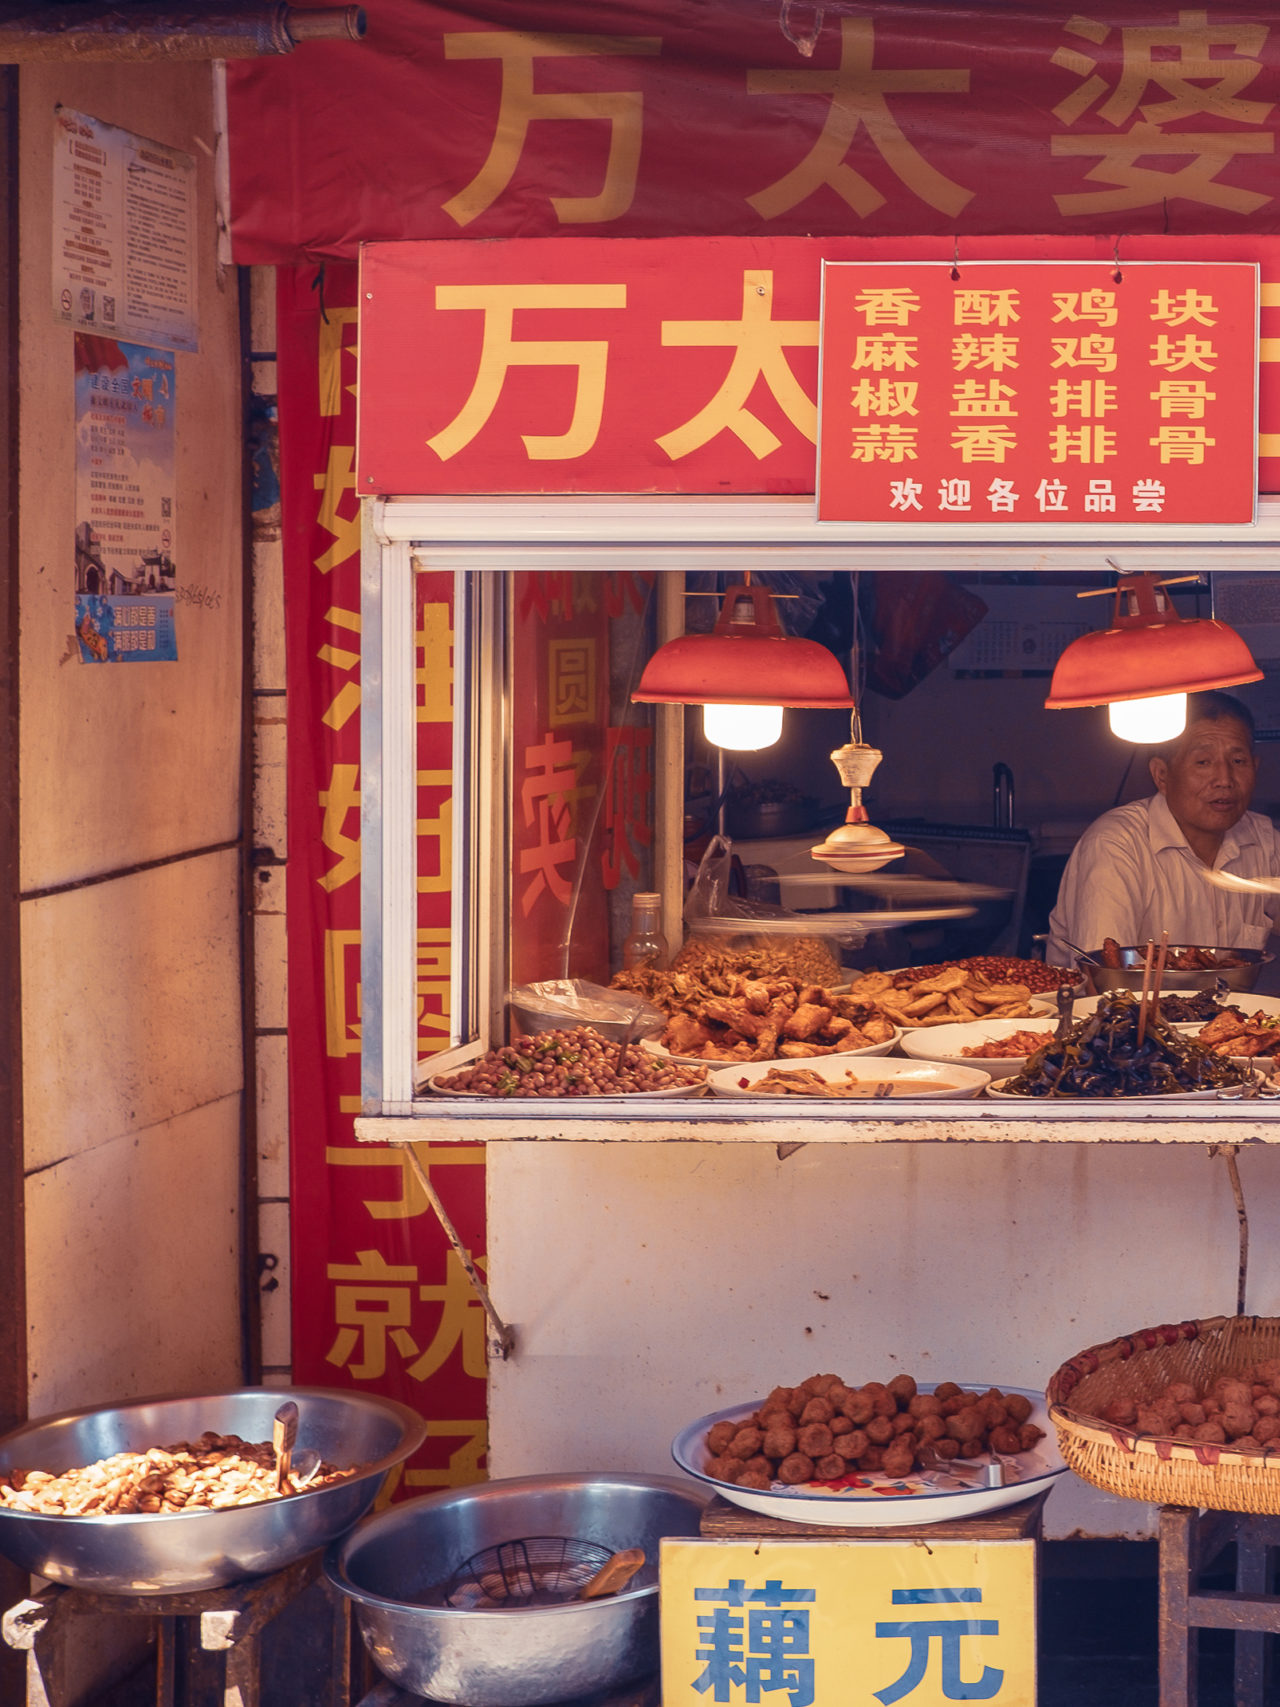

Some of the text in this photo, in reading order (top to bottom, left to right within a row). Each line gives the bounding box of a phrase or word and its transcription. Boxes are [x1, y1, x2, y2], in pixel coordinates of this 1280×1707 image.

[854, 287, 1219, 328] 香酥鸡块
[851, 332, 1218, 373] 麻辣鸡块
[851, 378, 1217, 419] 椒盐排骨
[850, 424, 1217, 465] 蒜香排骨
[889, 477, 1167, 513] 欢迎各位品尝
[690, 1578, 1006, 1707] 藕元
